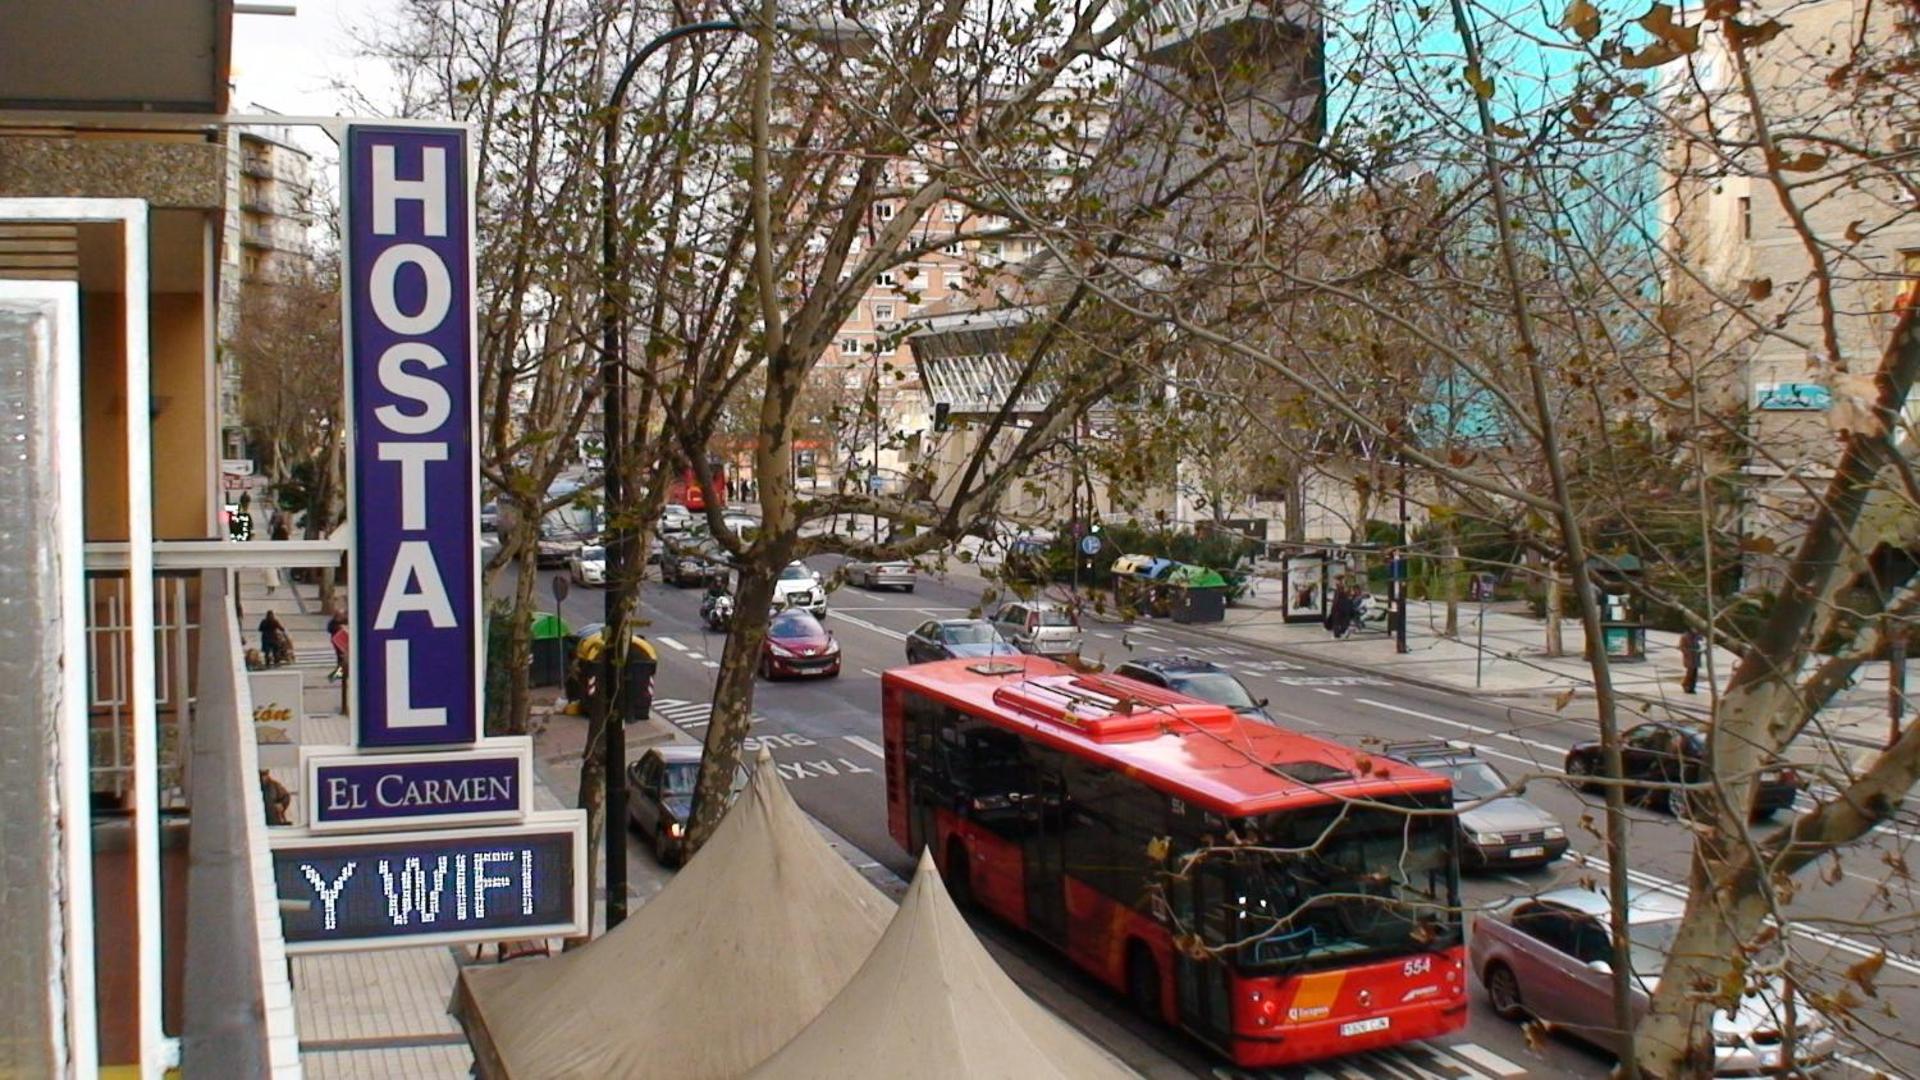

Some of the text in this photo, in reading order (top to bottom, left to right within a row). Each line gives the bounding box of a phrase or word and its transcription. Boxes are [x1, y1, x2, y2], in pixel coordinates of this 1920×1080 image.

[369, 144, 457, 729] HOSTAL
[776, 757, 874, 781] TAXI
[300, 849, 533, 930] Y WIFI
[1403, 957, 1431, 978] 554
